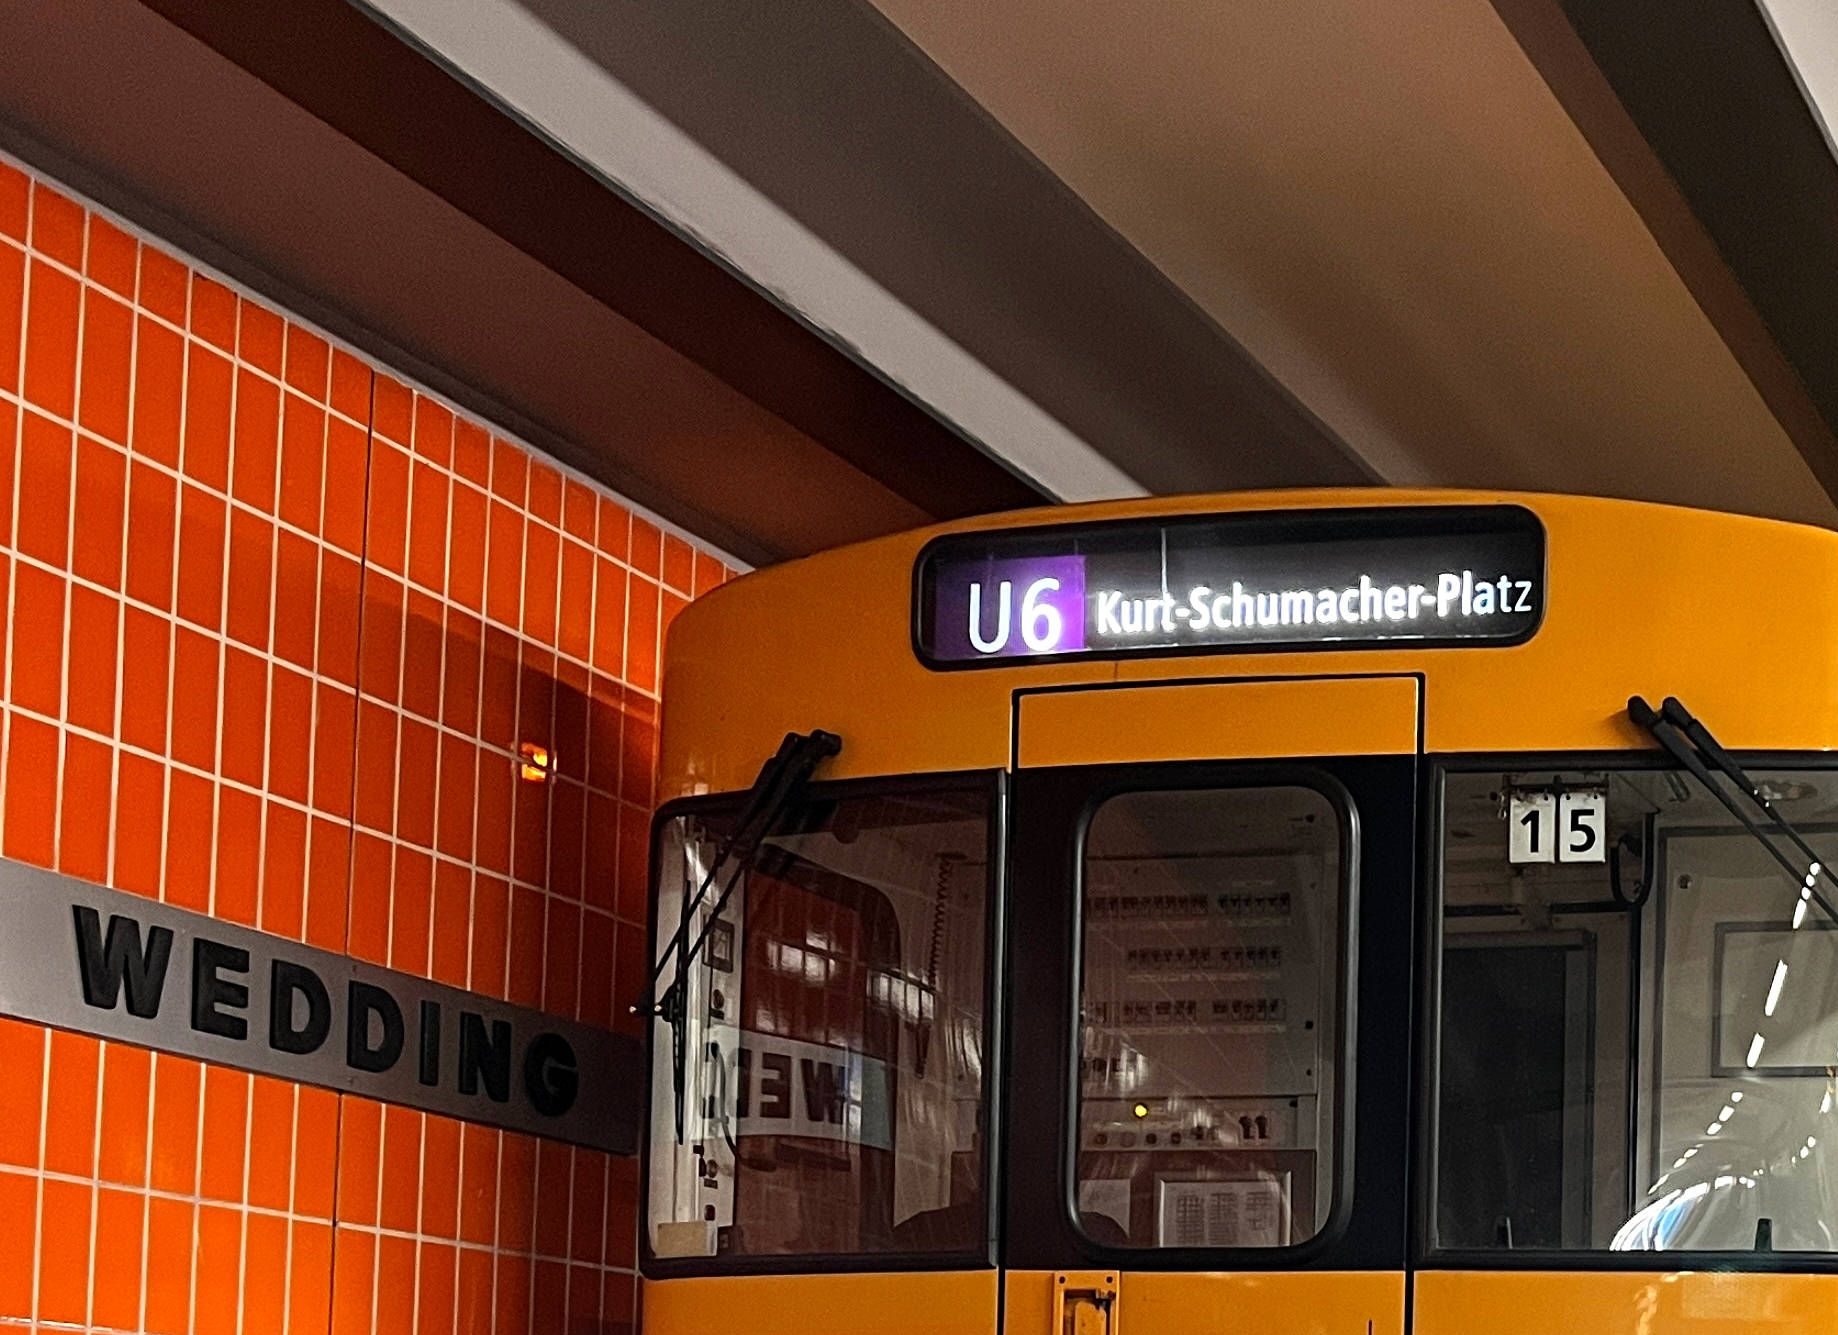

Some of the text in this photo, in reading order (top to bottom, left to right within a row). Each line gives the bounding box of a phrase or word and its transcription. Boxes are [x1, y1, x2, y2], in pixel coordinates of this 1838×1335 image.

[968, 570, 1533, 654] U6 Kurt-Schumacher-Platz
[1519, 809, 1597, 854] 15
[72, 903, 579, 1117] WEDDING
